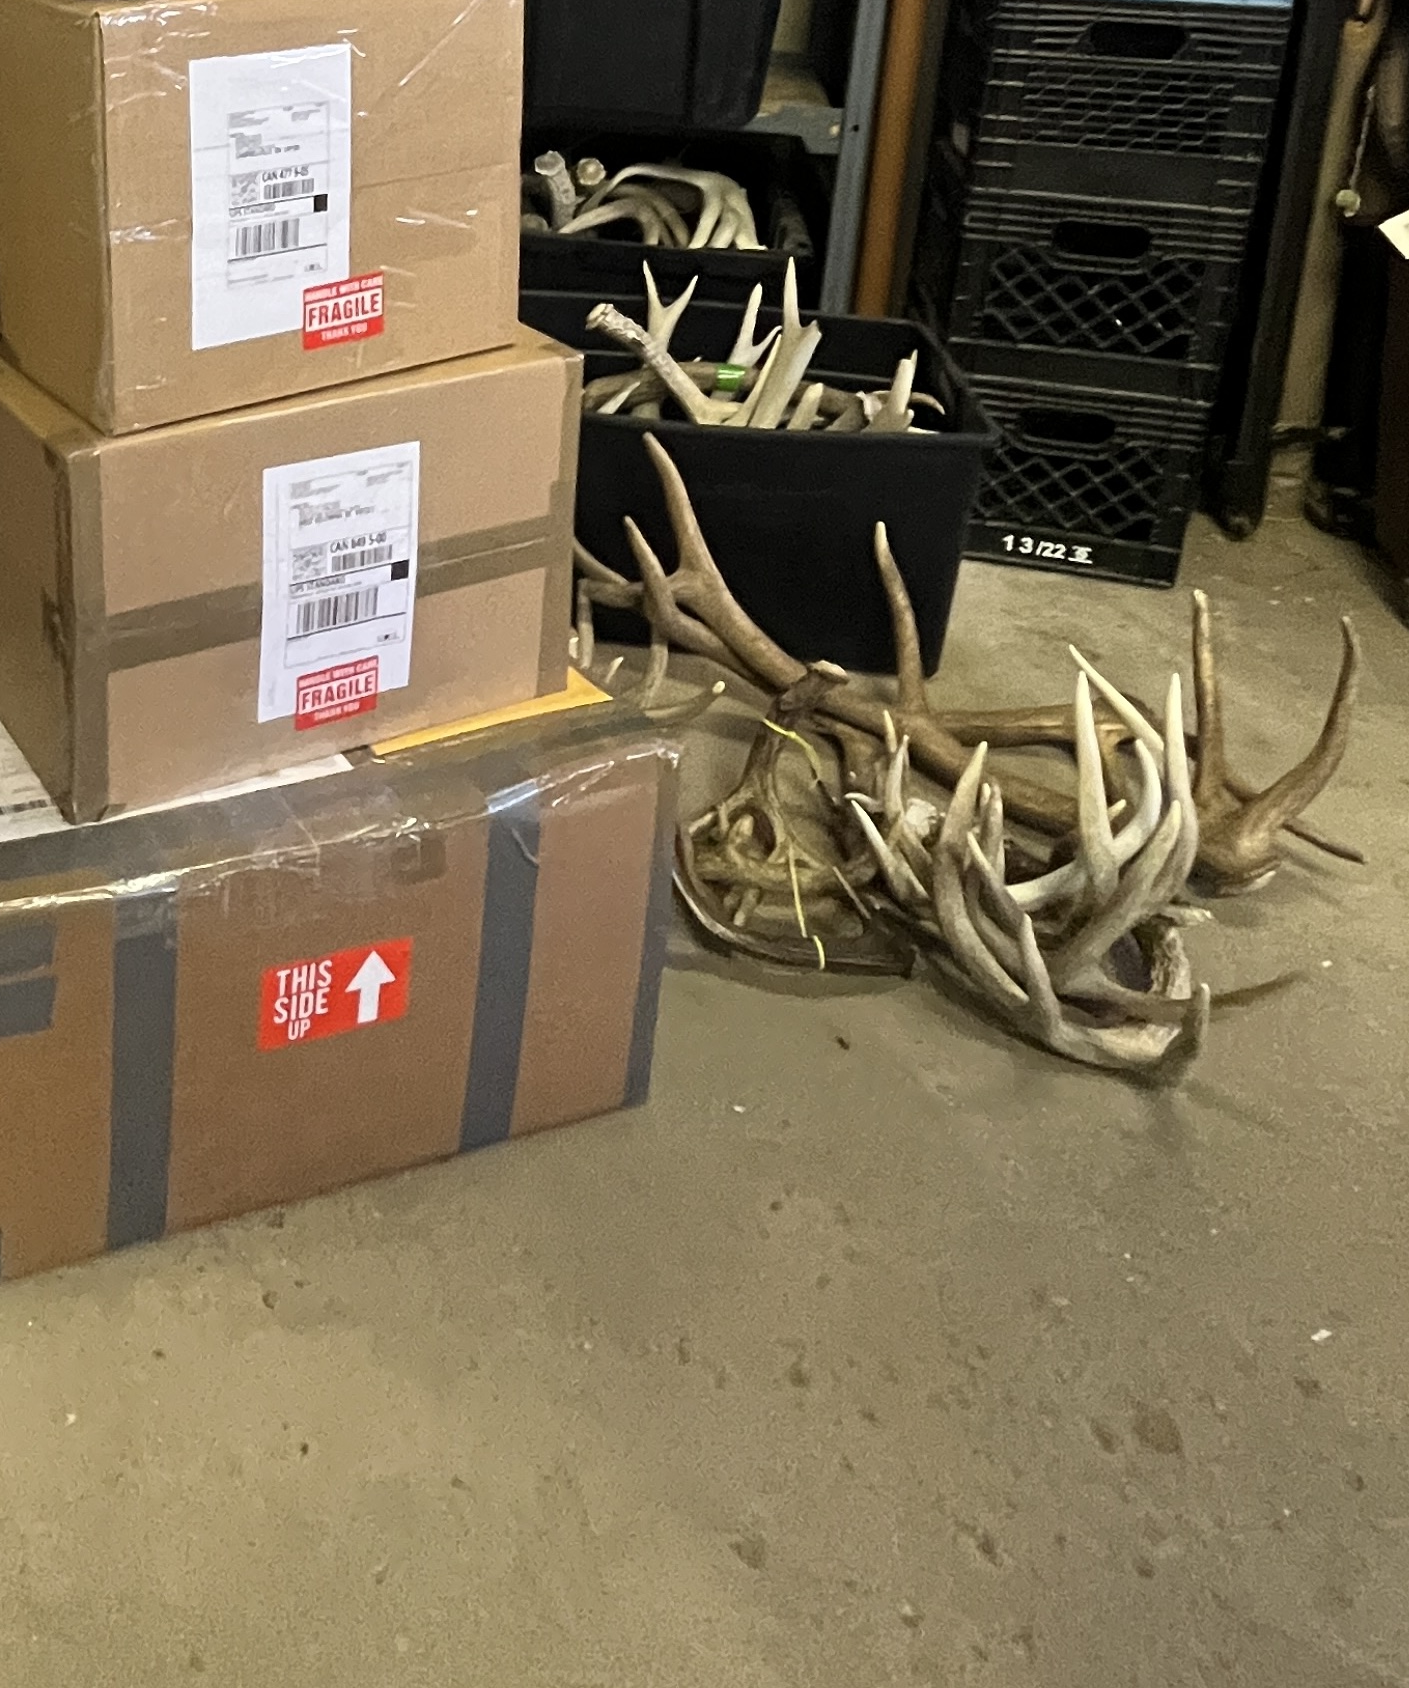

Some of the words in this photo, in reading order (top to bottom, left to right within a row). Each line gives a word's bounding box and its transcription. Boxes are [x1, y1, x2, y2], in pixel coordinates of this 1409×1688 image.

[309, 293, 380, 328] FRAGILE
[302, 674, 373, 710] FRAGILE
[277, 960, 333, 998] THIS
[273, 987, 331, 1025] SIDE
[288, 1019, 311, 1041] UP
